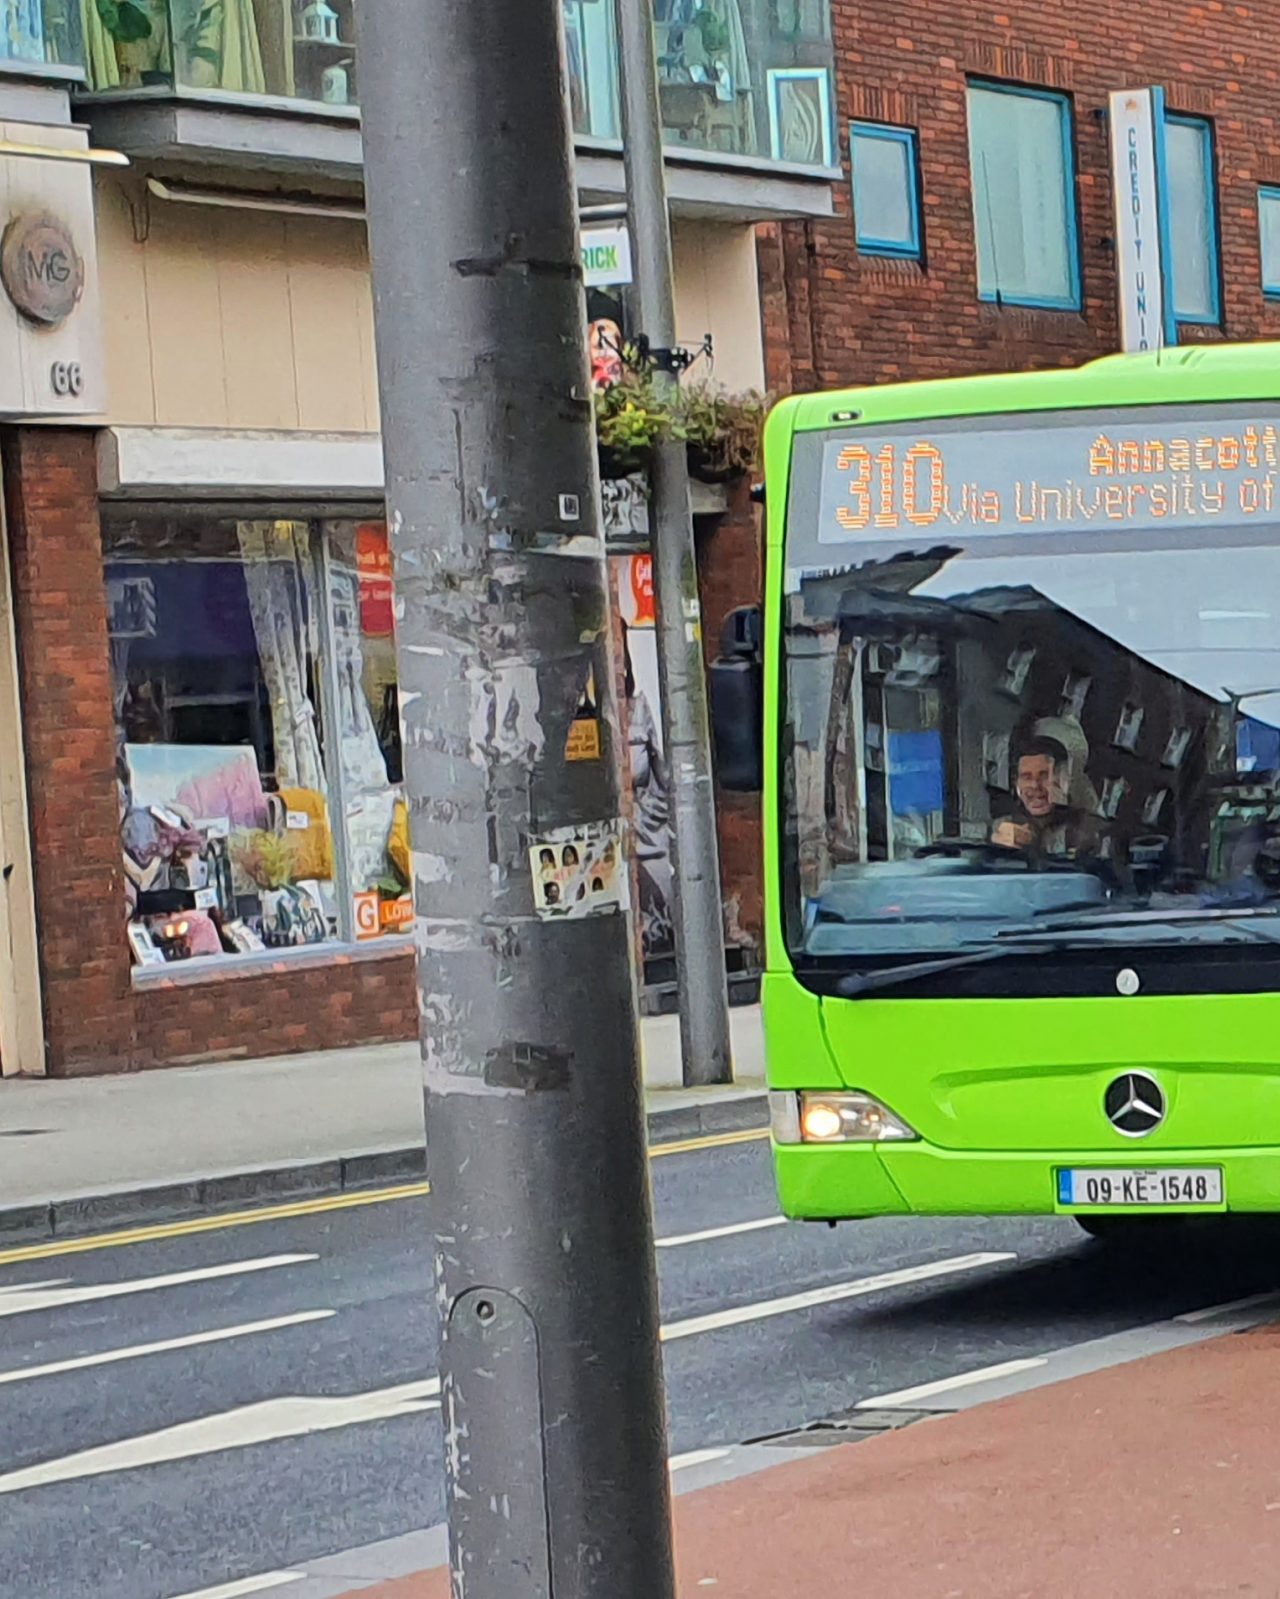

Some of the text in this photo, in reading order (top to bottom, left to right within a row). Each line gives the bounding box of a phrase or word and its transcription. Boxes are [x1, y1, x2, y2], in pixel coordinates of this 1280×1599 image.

[1128, 127, 1141, 260] CREDIT
[27, 247, 71, 283] MG
[51, 361, 84, 396] 66
[836, 440, 943, 529] 310
[1014, 471, 1225, 523] University
[1238, 469, 1279, 512] of
[1086, 1175, 1208, 1203] 09-KE-1548
